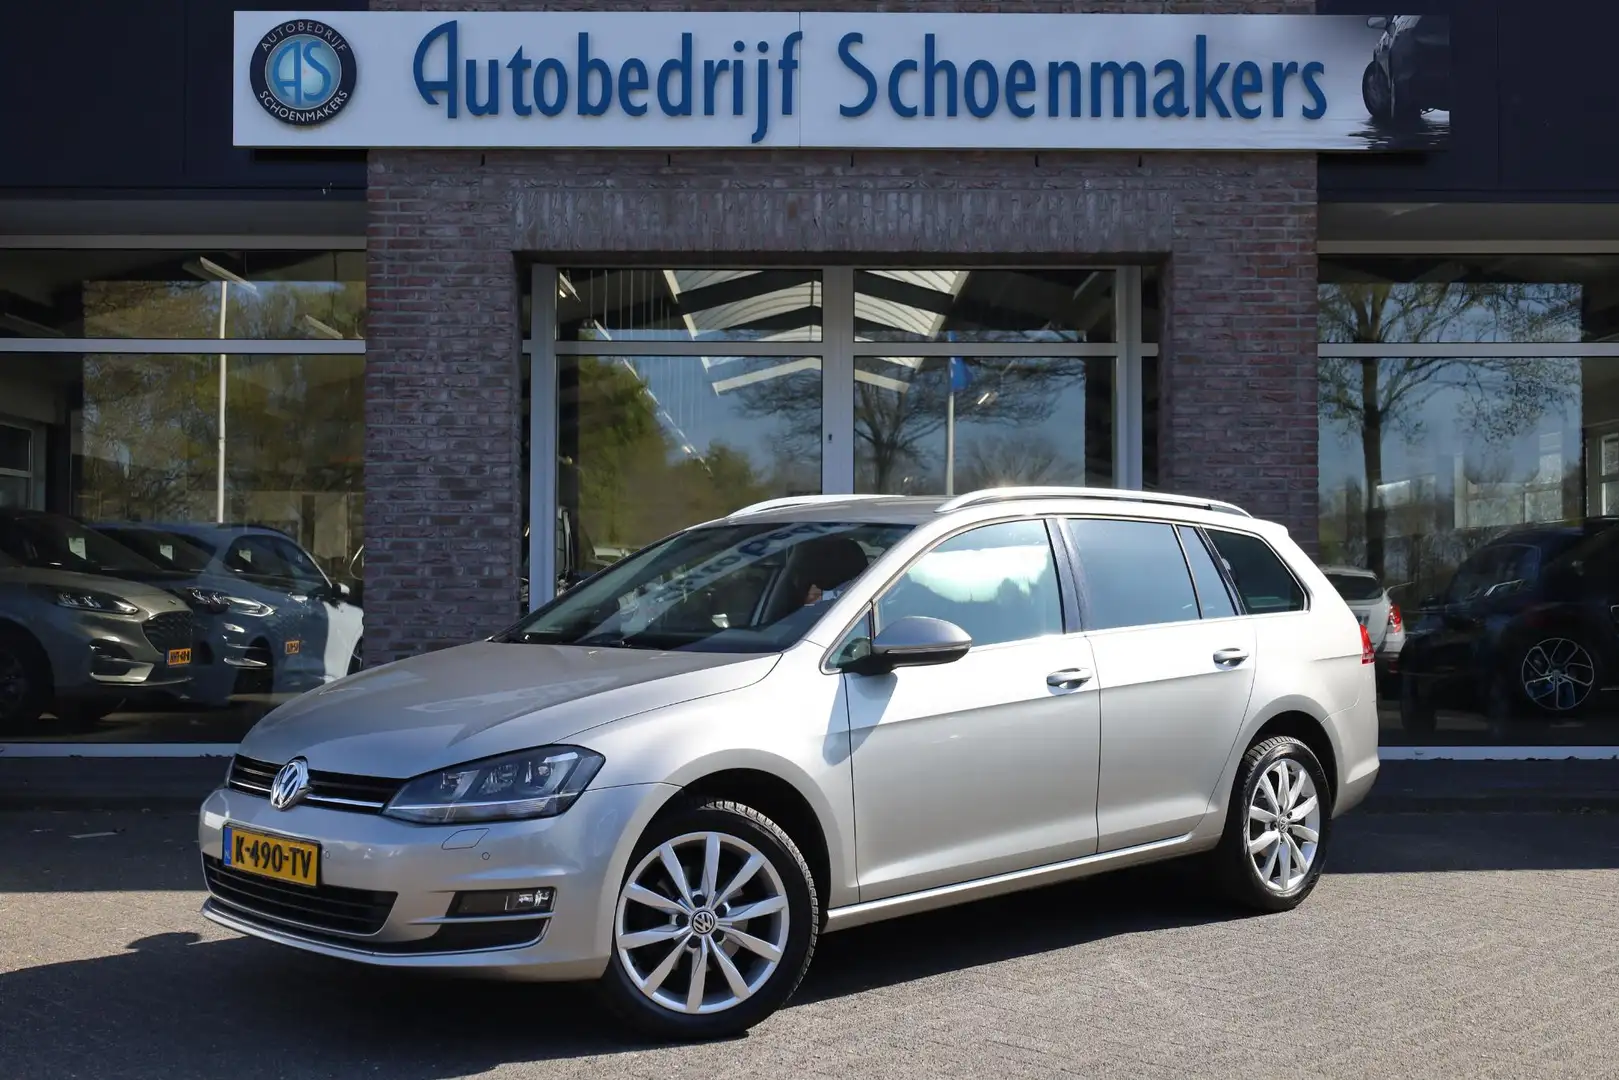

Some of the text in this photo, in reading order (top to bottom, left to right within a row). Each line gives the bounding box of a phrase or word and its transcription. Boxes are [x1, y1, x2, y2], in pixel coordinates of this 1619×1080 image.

[261, 21, 347, 52] AUTOBEDRIJF
[273, 40, 331, 106] AS
[413, 20, 1328, 144] Autobedrijf Schoenmakers
[260, 90, 348, 122] SCHOENMAKERS
[235, 835, 312, 879] K-490-TV
